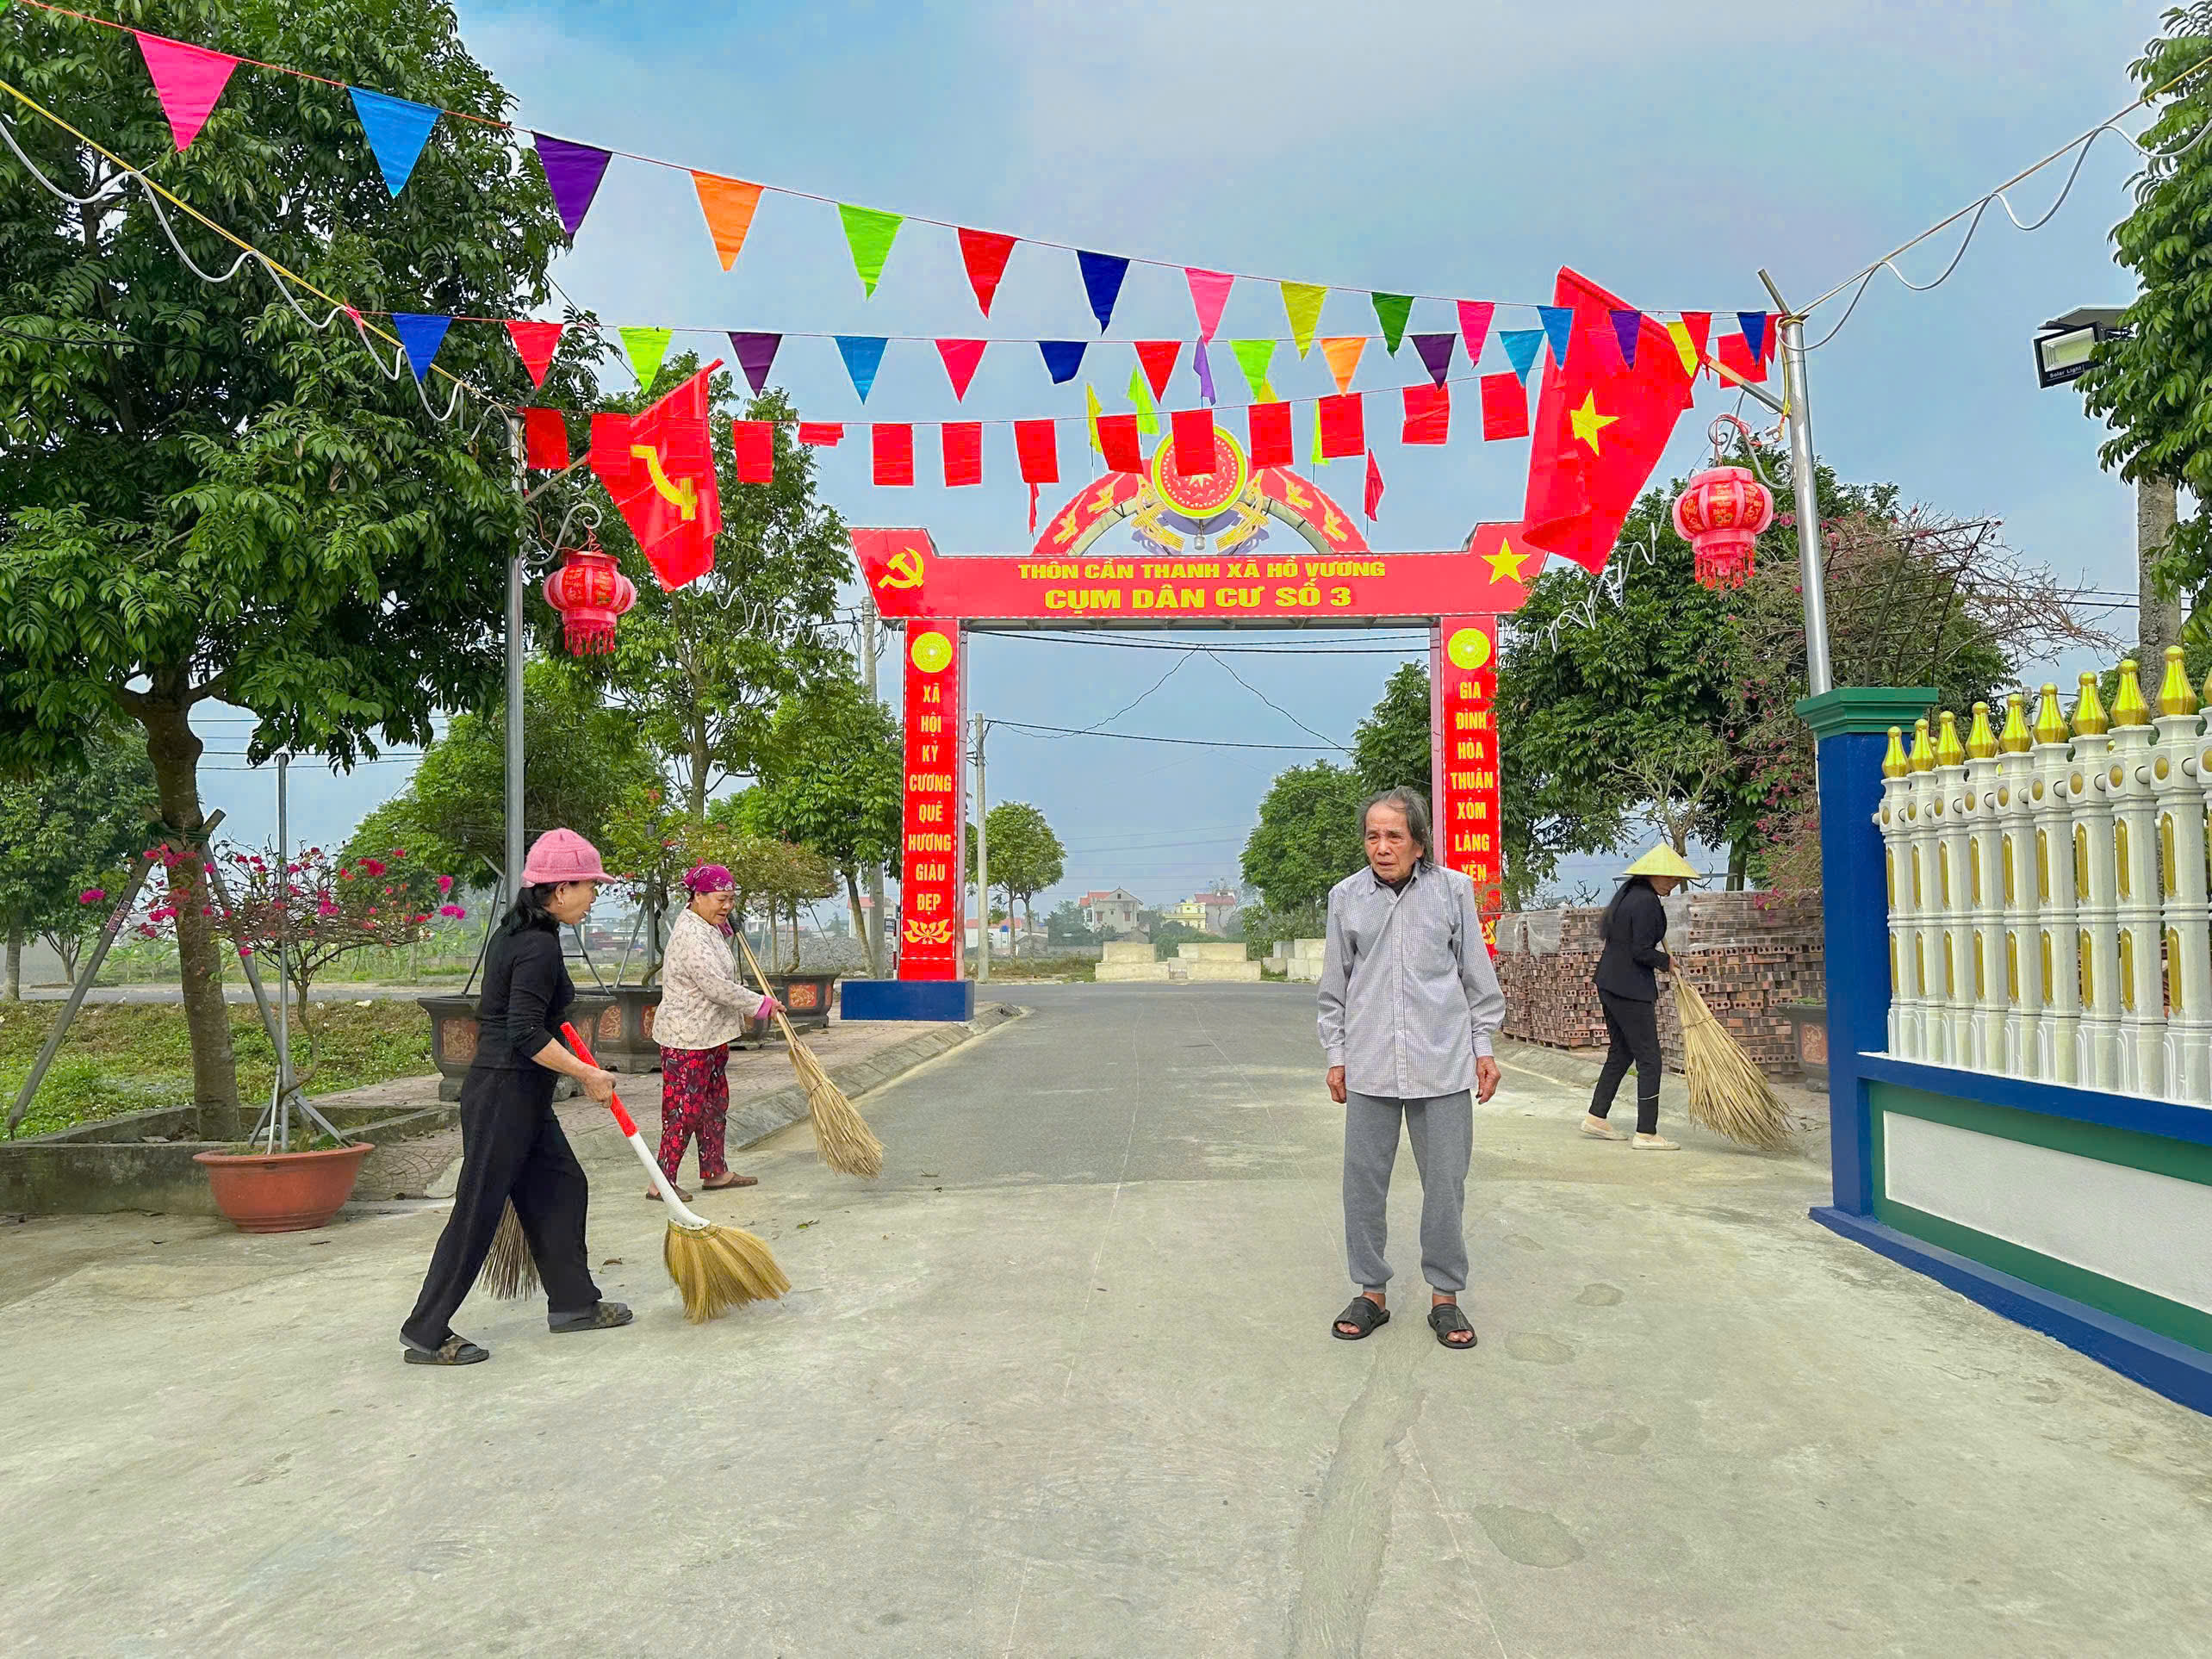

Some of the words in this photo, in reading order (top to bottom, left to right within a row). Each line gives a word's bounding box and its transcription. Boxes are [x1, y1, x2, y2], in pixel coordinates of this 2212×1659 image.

[1018, 561, 1078, 579] THÔN
[1141, 563, 1220, 578] THANH
[1227, 560, 1260, 578] XÃ
[1305, 561, 1386, 577] VƯƠNG
[1045, 588, 1121, 614] CỤM
[1132, 584, 1205, 608] DÂN
[1215, 586, 1265, 607] CƯ
[1275, 578, 1320, 607] SỐ
[1330, 587, 1351, 606] 3
[923, 682, 941, 703] XÃ
[1460, 681, 1482, 699] GIA
[921, 711, 941, 736] HỘI
[910, 774, 952, 792] CƯƠNG
[1450, 767, 1494, 792] THUẬN
[919, 801, 943, 823] QUÊ
[908, 833, 952, 851] HƯƠNG
[916, 893, 941, 916] ĐẸP
